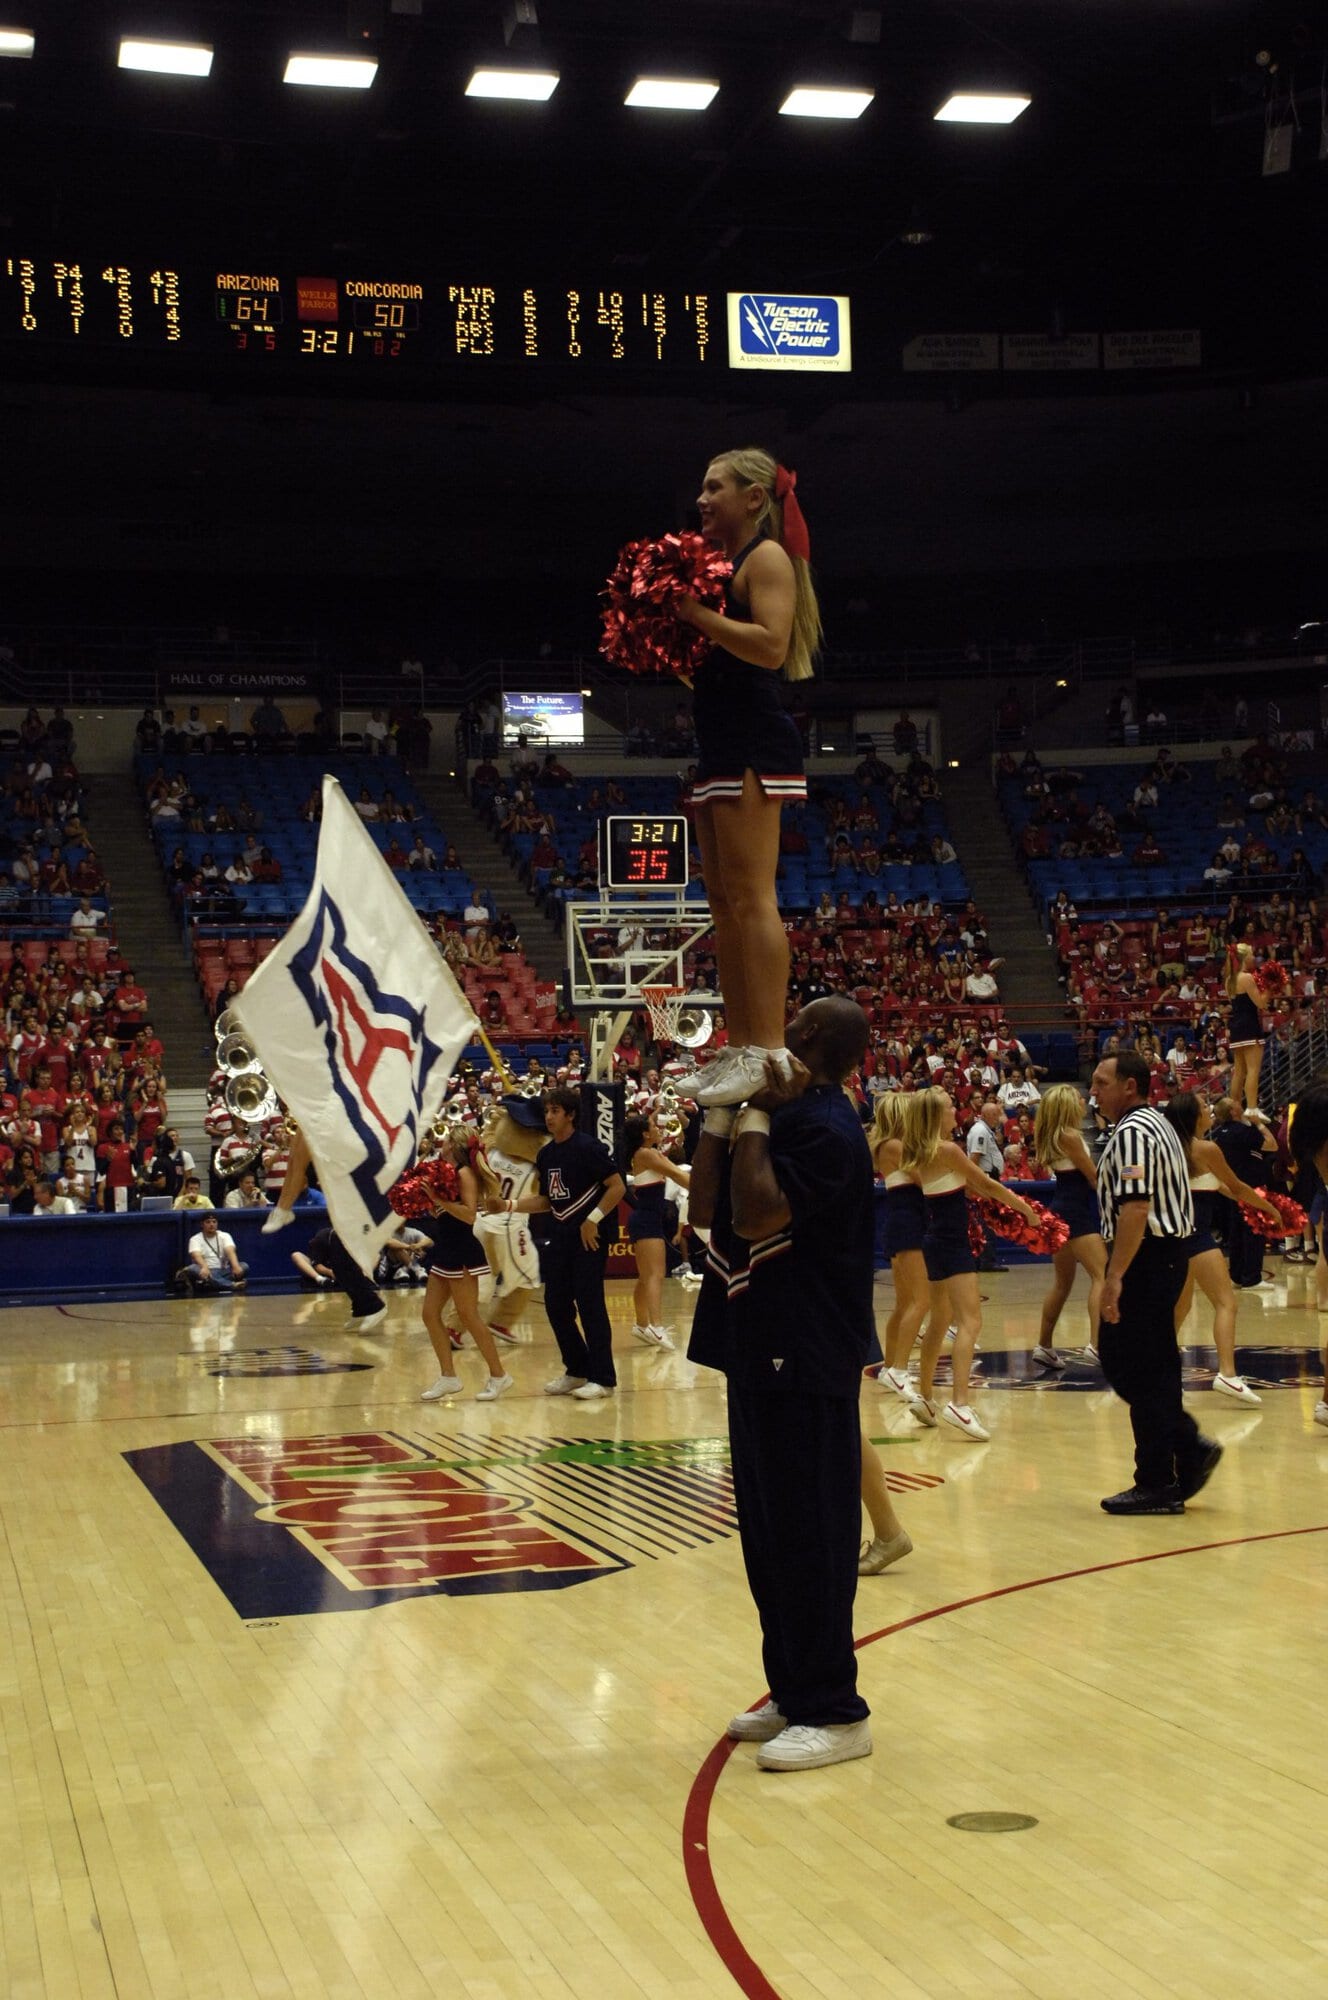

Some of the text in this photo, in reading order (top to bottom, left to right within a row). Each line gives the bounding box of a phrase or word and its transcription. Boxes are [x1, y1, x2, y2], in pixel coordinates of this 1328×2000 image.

[8, 259, 179, 288] 13 34 42 43
[216, 274, 280, 292] ARIZONA
[20, 278, 35, 295] 9
[118, 286, 132, 302] 6
[153, 288, 179, 305] 12
[298, 290, 336, 300] WELLS
[345, 281, 423, 299] CONCORDIA
[449, 286, 708, 311] PLYR 6 9 10 12 15
[24, 296, 180, 323] 1 3 3 4
[237, 297, 268, 320] 64
[300, 300, 336, 310] FARGO
[374, 303, 405, 328] 50
[457, 303, 490, 320] PTS
[696, 312, 708, 328] 6
[763, 302, 818, 318] Tucson
[22, 314, 180, 340] 0 1 0 3
[455, 321, 494, 338] RBS
[524, 323, 537, 339] 3
[570, 324, 576, 341] 1
[653, 327, 667, 343] 7
[697, 329, 709, 345] 3
[770, 318, 830, 333] Electric
[301, 329, 353, 354] 3:21
[456, 338, 494, 355] FLS
[525, 340, 538, 356] 2
[568, 341, 582, 357] 0
[657, 344, 662, 360] 1
[699, 346, 704, 361] 1
[776, 332, 831, 347] Power
[170, 673, 307, 686] HALL OF CHAMPIONS
[520, 695, 565, 704] The Future.
[631, 824, 678, 842] 3:21
[628, 850, 668, 880] 35
[1007, 1091, 1030, 1099] ARIZONA
[548, 1168, 571, 1201] A
[196, 1433, 612, 1591] ARIZONA
